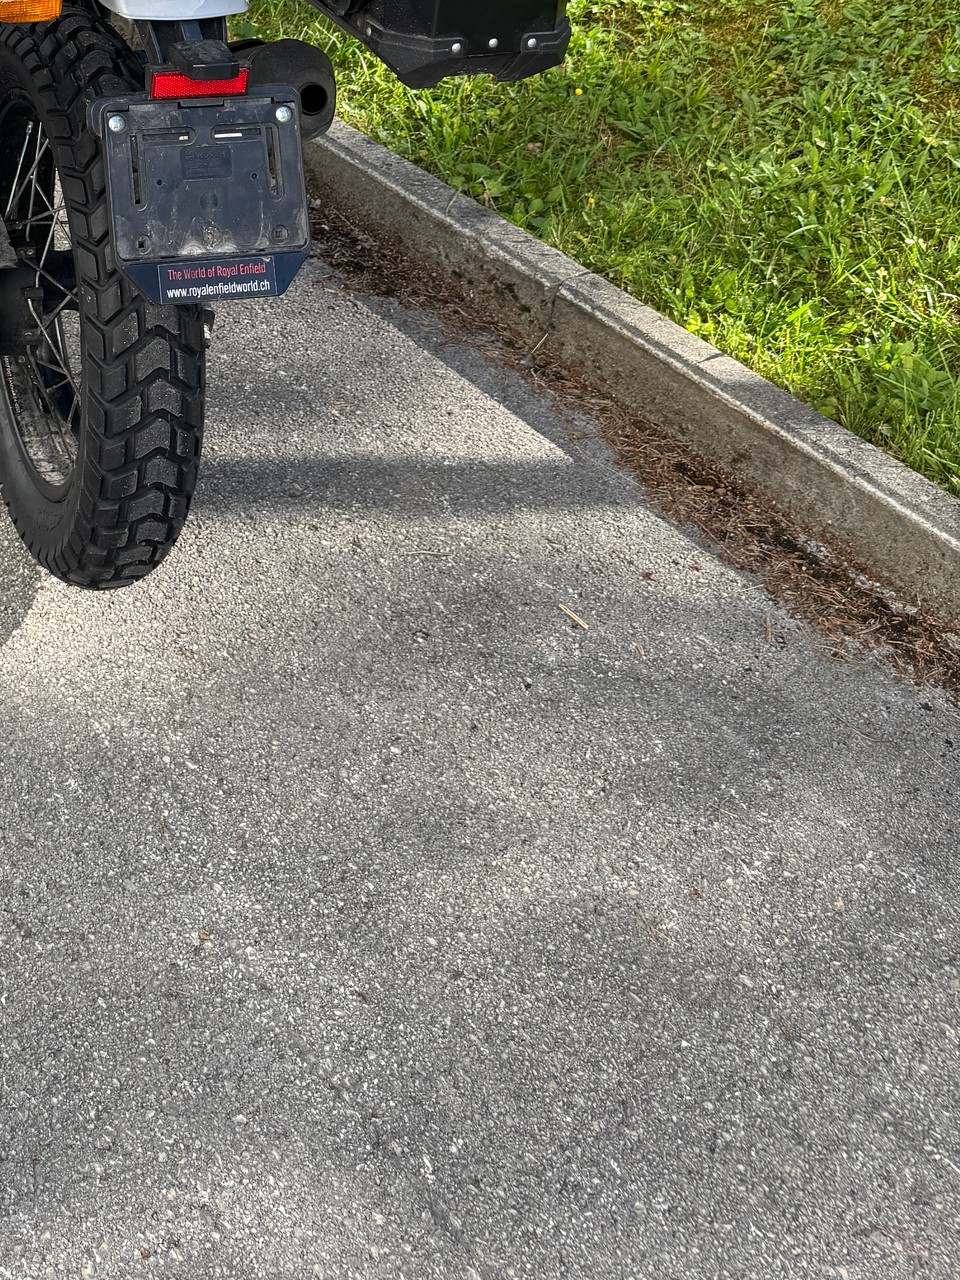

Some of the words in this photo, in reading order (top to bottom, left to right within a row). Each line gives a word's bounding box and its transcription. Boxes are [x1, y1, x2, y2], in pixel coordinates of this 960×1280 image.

[168, 269, 182, 280] The
[184, 268, 206, 279] World
[207, 266, 215, 278] of
[217, 265, 238, 278] Royal
[240, 263, 266, 275] Enfield
[167, 279, 270, 298] www.royalenfieldworld.ch
